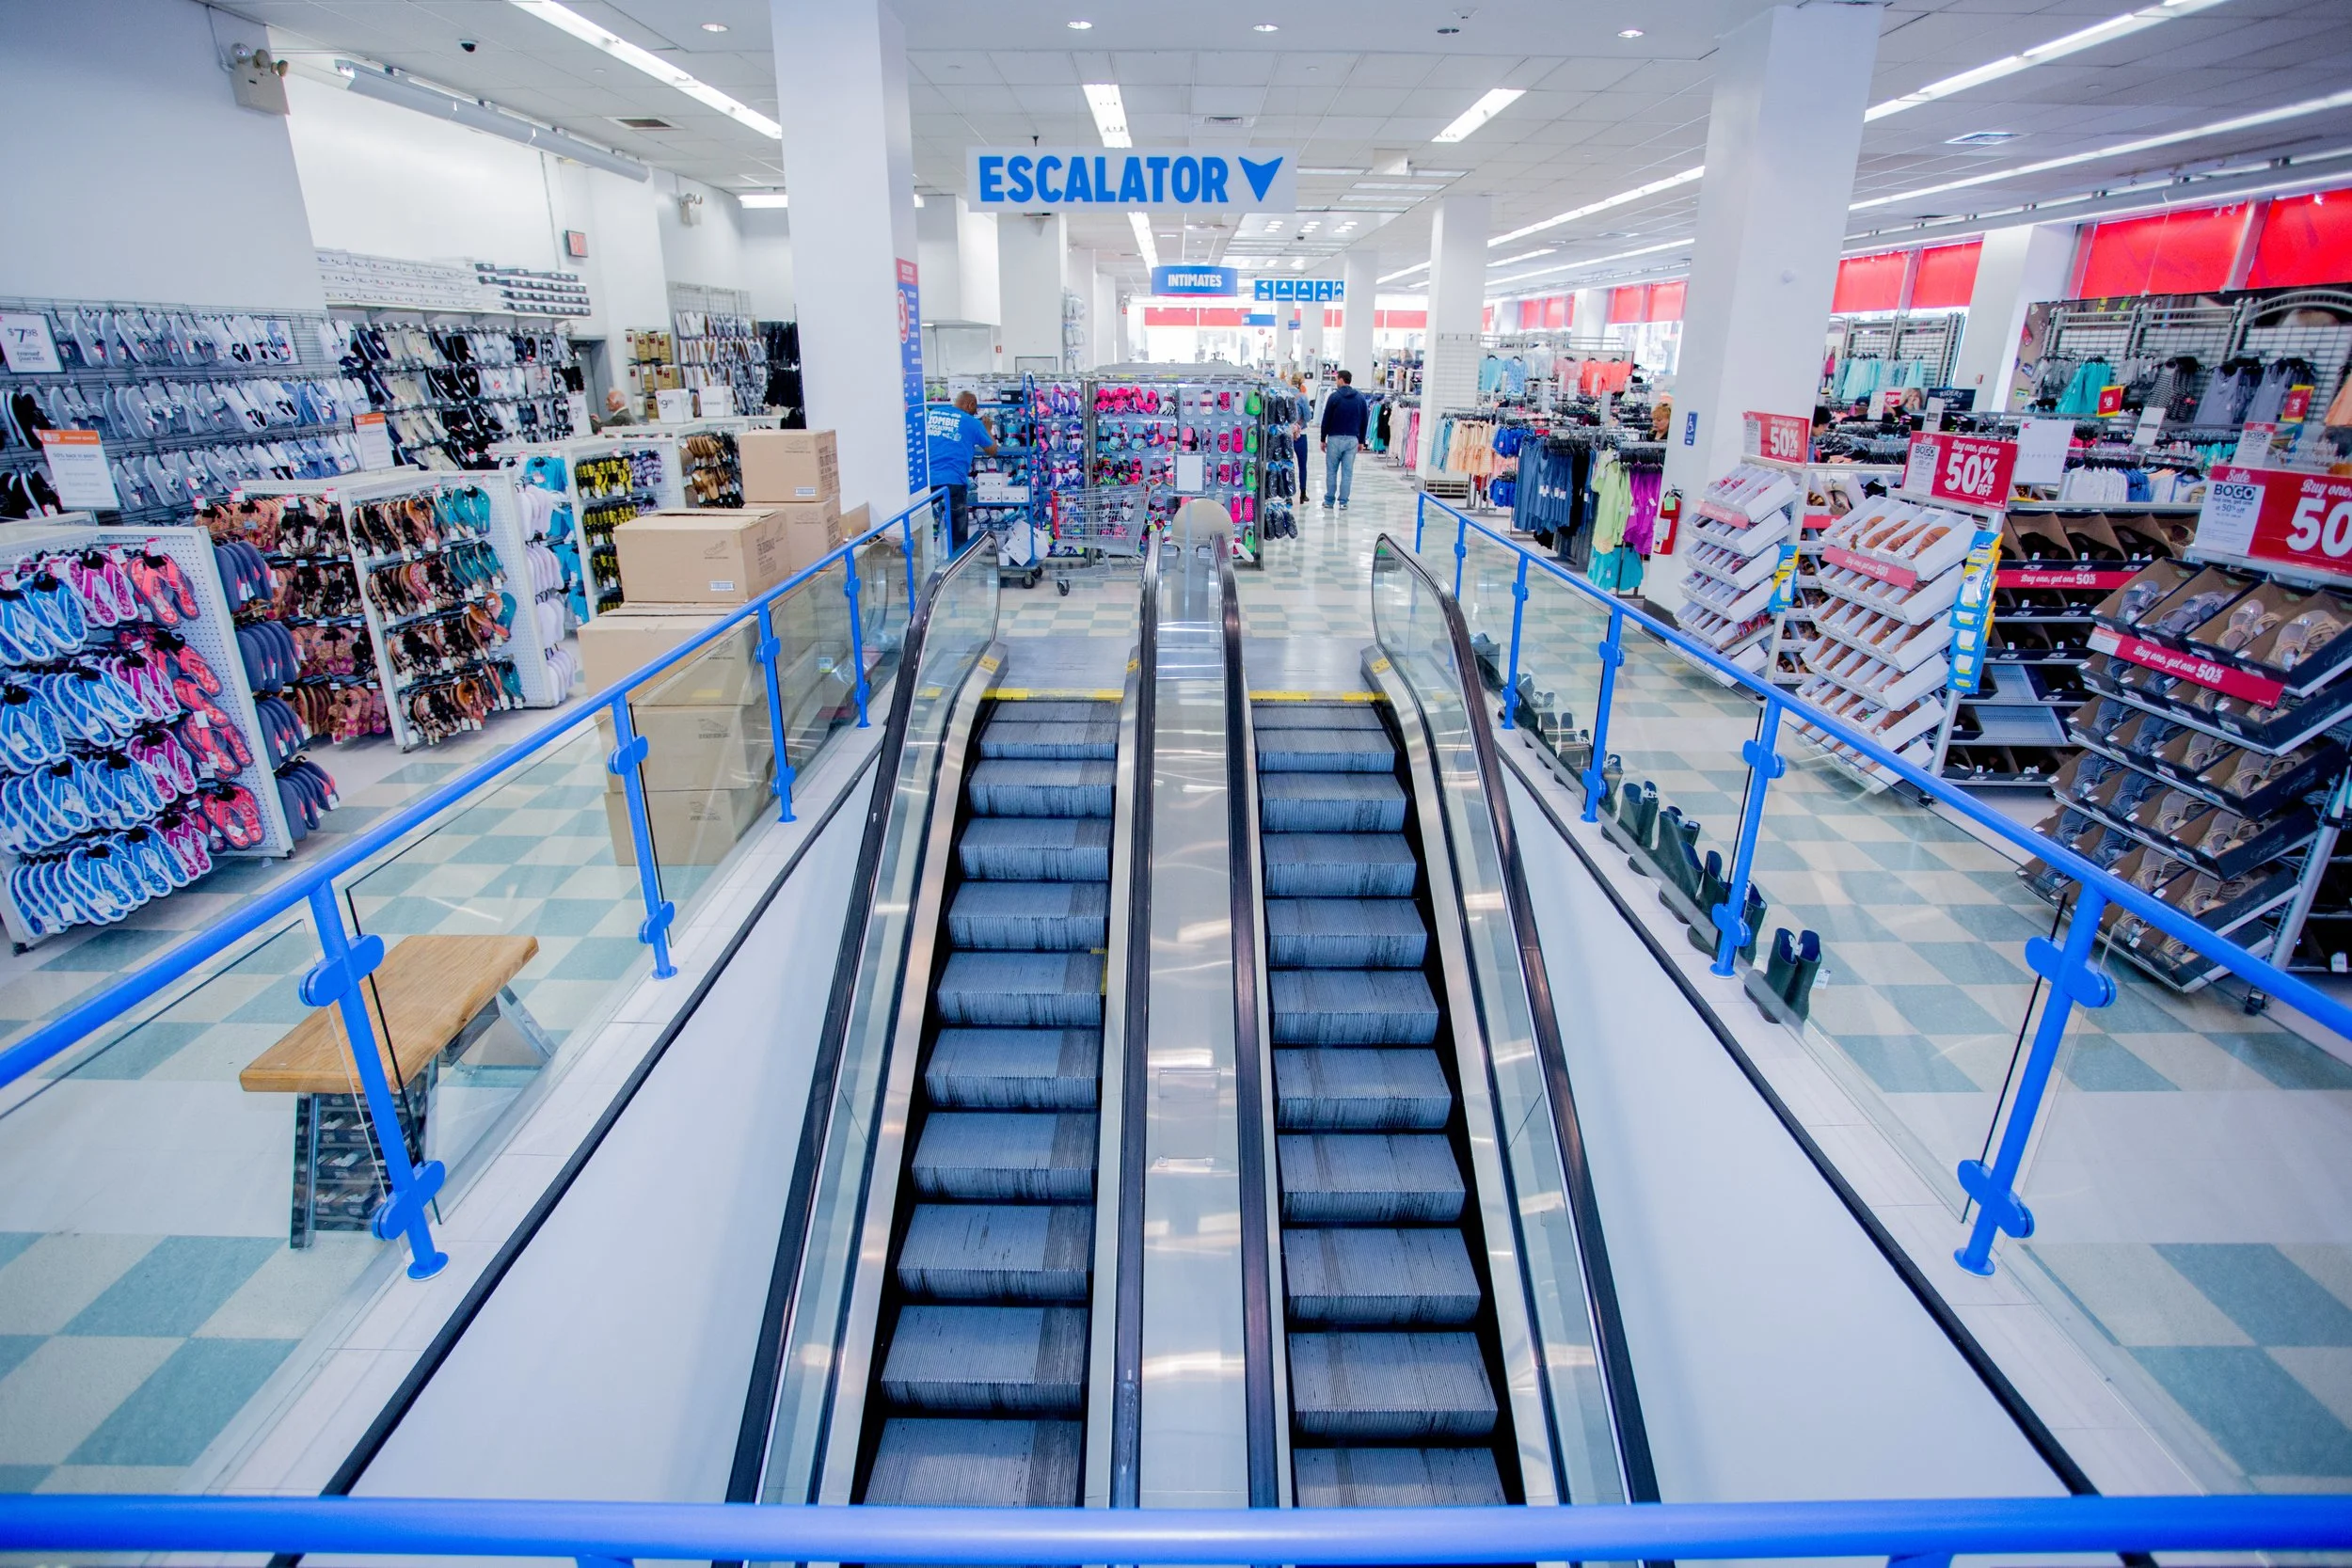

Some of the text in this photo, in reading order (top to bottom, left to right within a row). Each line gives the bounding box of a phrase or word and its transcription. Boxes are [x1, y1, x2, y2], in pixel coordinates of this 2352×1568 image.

[979, 155, 1229, 203] ESCALATOR
[1168, 274, 1222, 288] INTIMATES
[1940, 389, 1964, 399] RIDERS
[928, 416, 961, 428] ZOMBIE
[1770, 426, 1799, 457] 50%
[1951, 439, 1965, 453] Buy
[1977, 444, 1990, 456] get
[1988, 447, 2000, 455] one
[1915, 445, 1936, 457] BOGO
[1944, 452, 1998, 494] 50%
[2226, 469, 2250, 483] Sale
[1977, 483, 1994, 497] OFF
[2214, 483, 2256, 500] BOGO
[2300, 479, 2328, 499] Buy
[2286, 496, 2352, 558] 50
[2021, 574, 2036, 585] Buy
[2051, 574, 2063, 585] get
[2062, 575, 2075, 583] one
[2133, 645, 2152, 661] Buy
[2165, 657, 2183, 669] get
[2180, 662, 2197, 673] one
[2195, 663, 2224, 682] 50%
